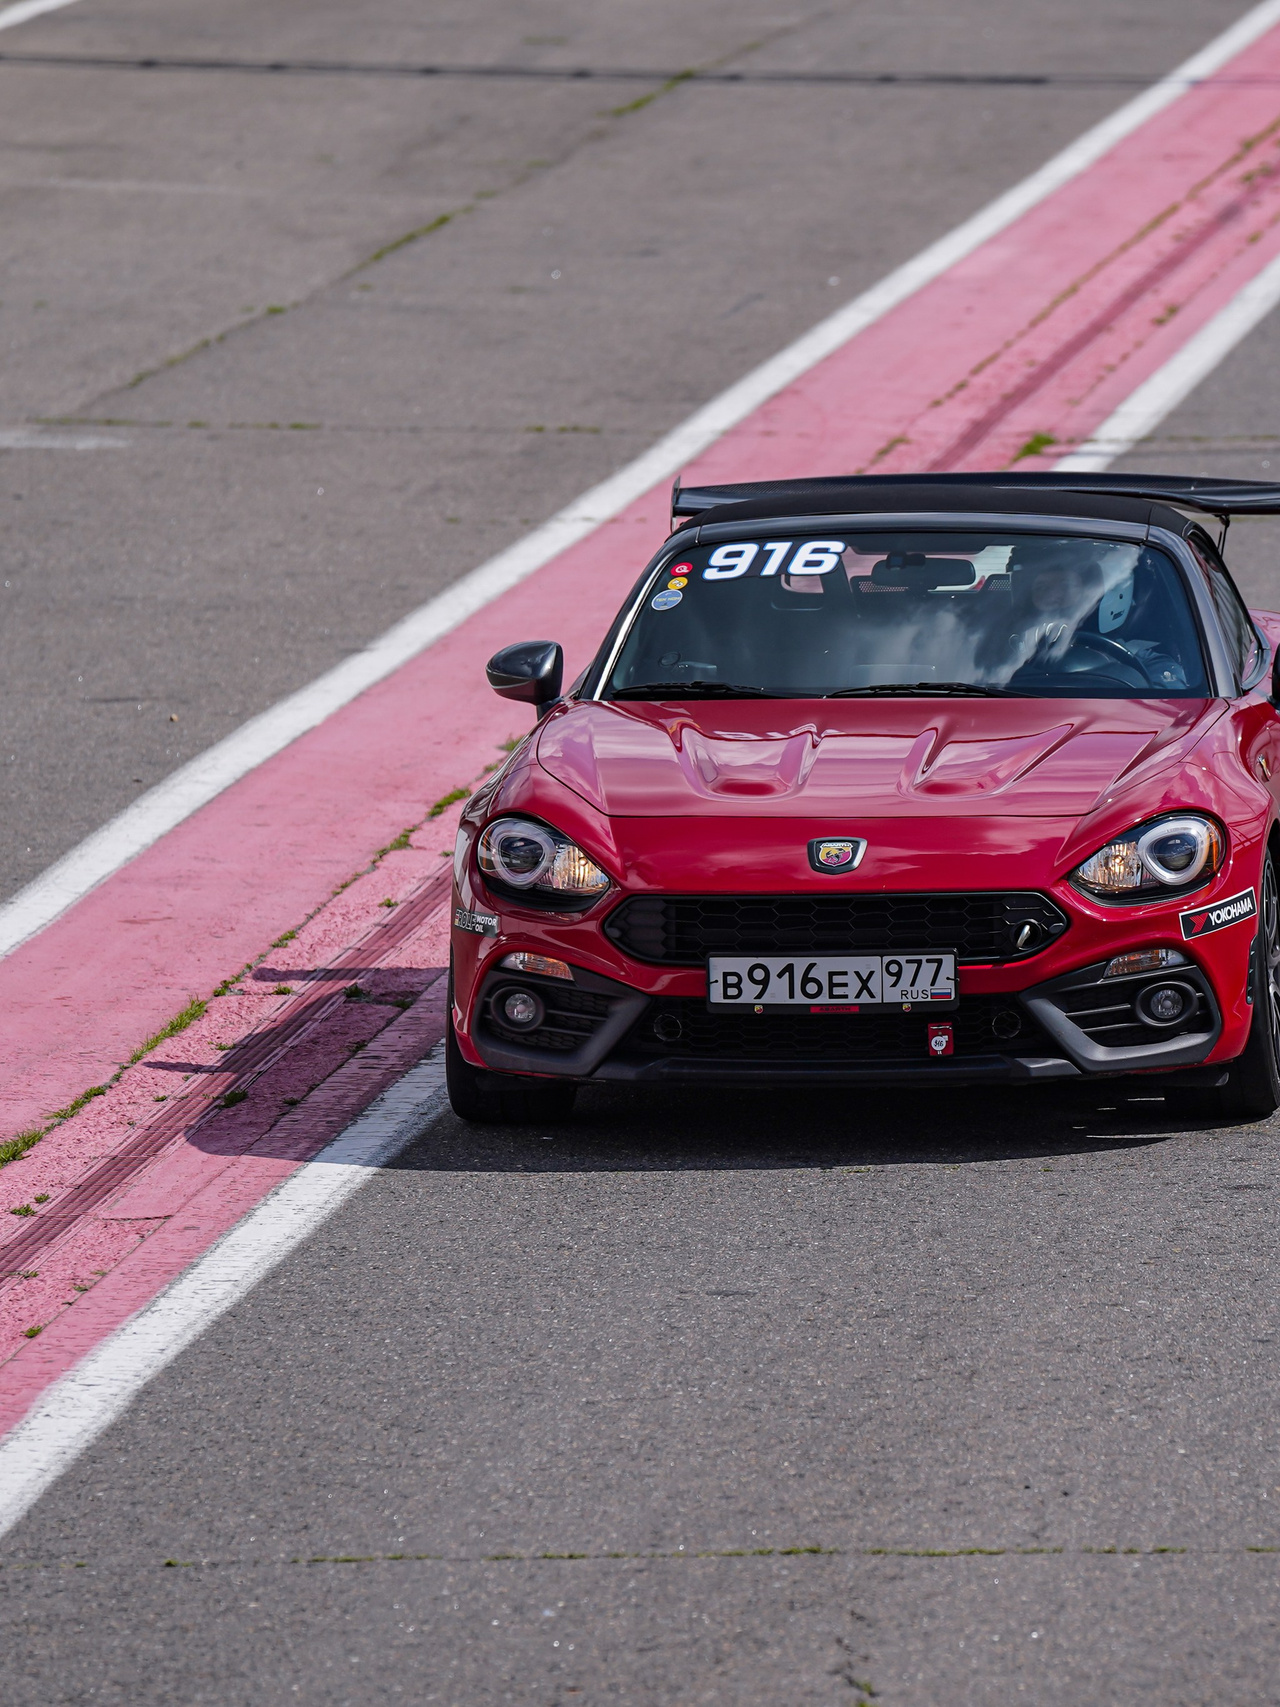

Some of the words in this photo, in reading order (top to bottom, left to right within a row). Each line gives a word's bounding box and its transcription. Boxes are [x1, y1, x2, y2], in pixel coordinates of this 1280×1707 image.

[702, 541, 846, 581] 916
[476, 915, 497, 927] MOTOR
[1208, 897, 1253, 926] YOKOHAMA
[474, 924, 484, 933] OIL
[885, 958, 943, 988] 977
[901, 989, 929, 1000] RUS
